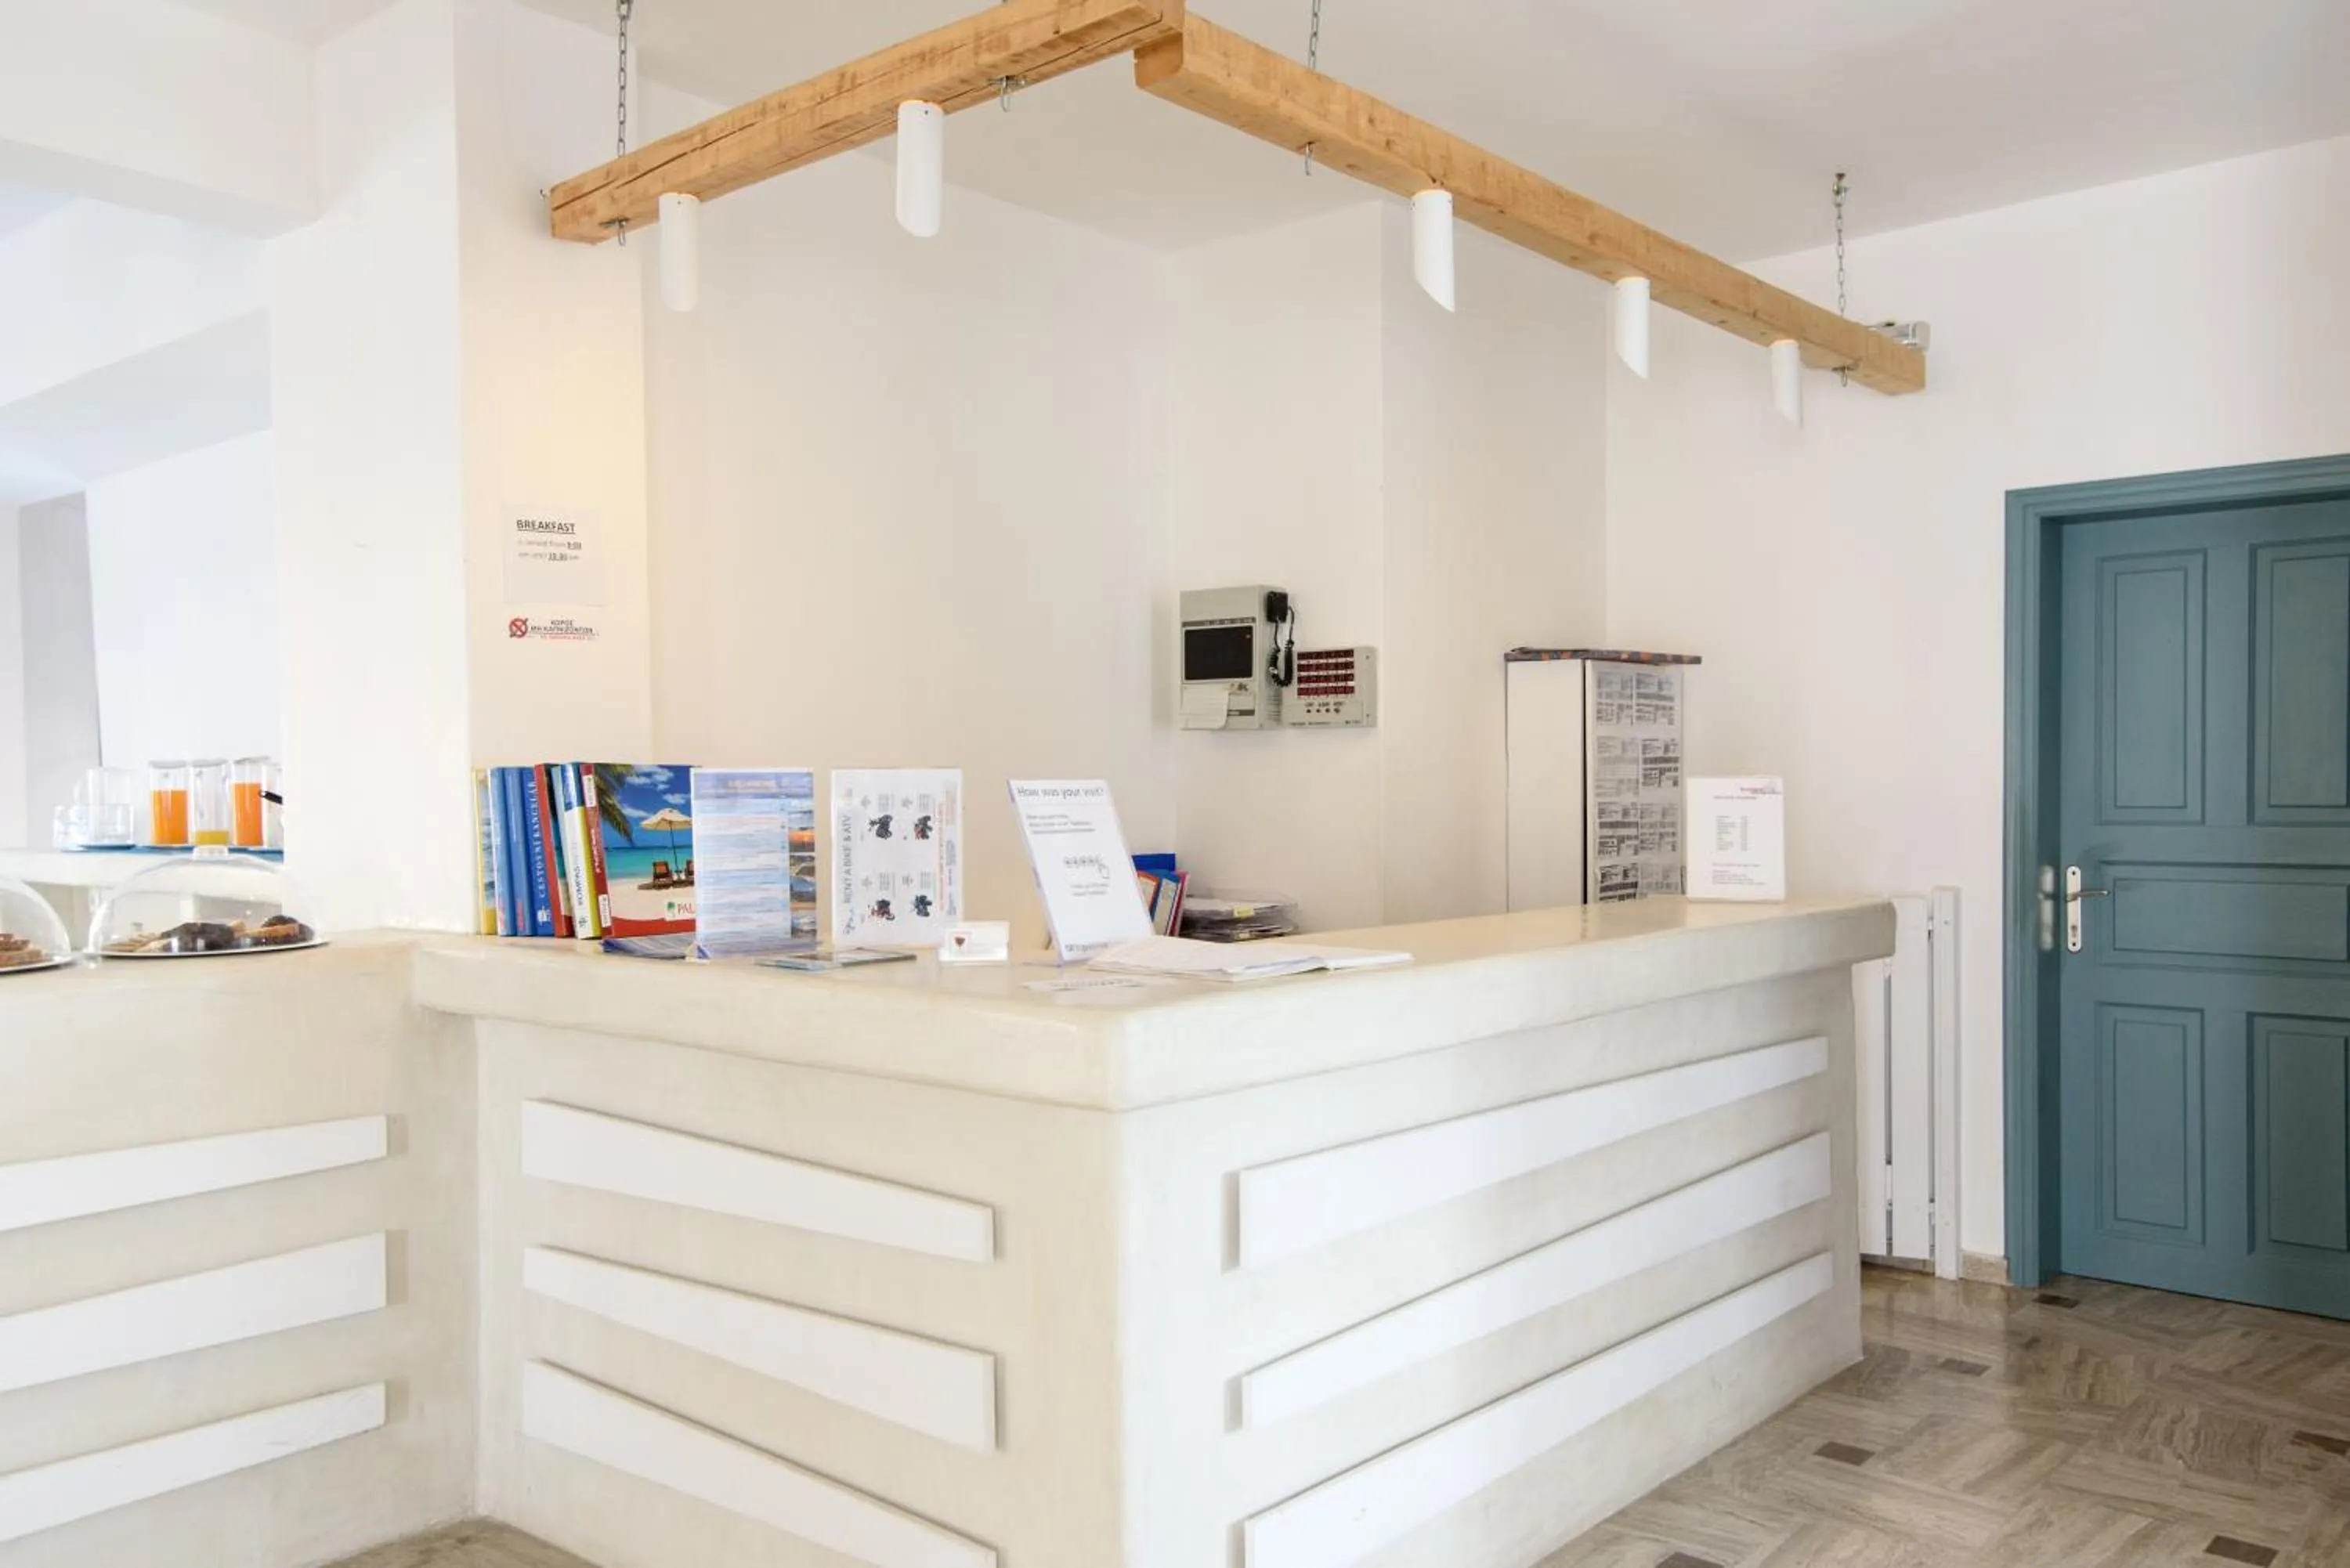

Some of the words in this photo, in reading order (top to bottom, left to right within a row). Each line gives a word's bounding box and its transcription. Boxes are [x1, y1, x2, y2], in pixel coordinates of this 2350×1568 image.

[516, 519, 575, 533] BREAKFAST
[1017, 786, 1039, 797] How
[1061, 788, 1080, 799] your
